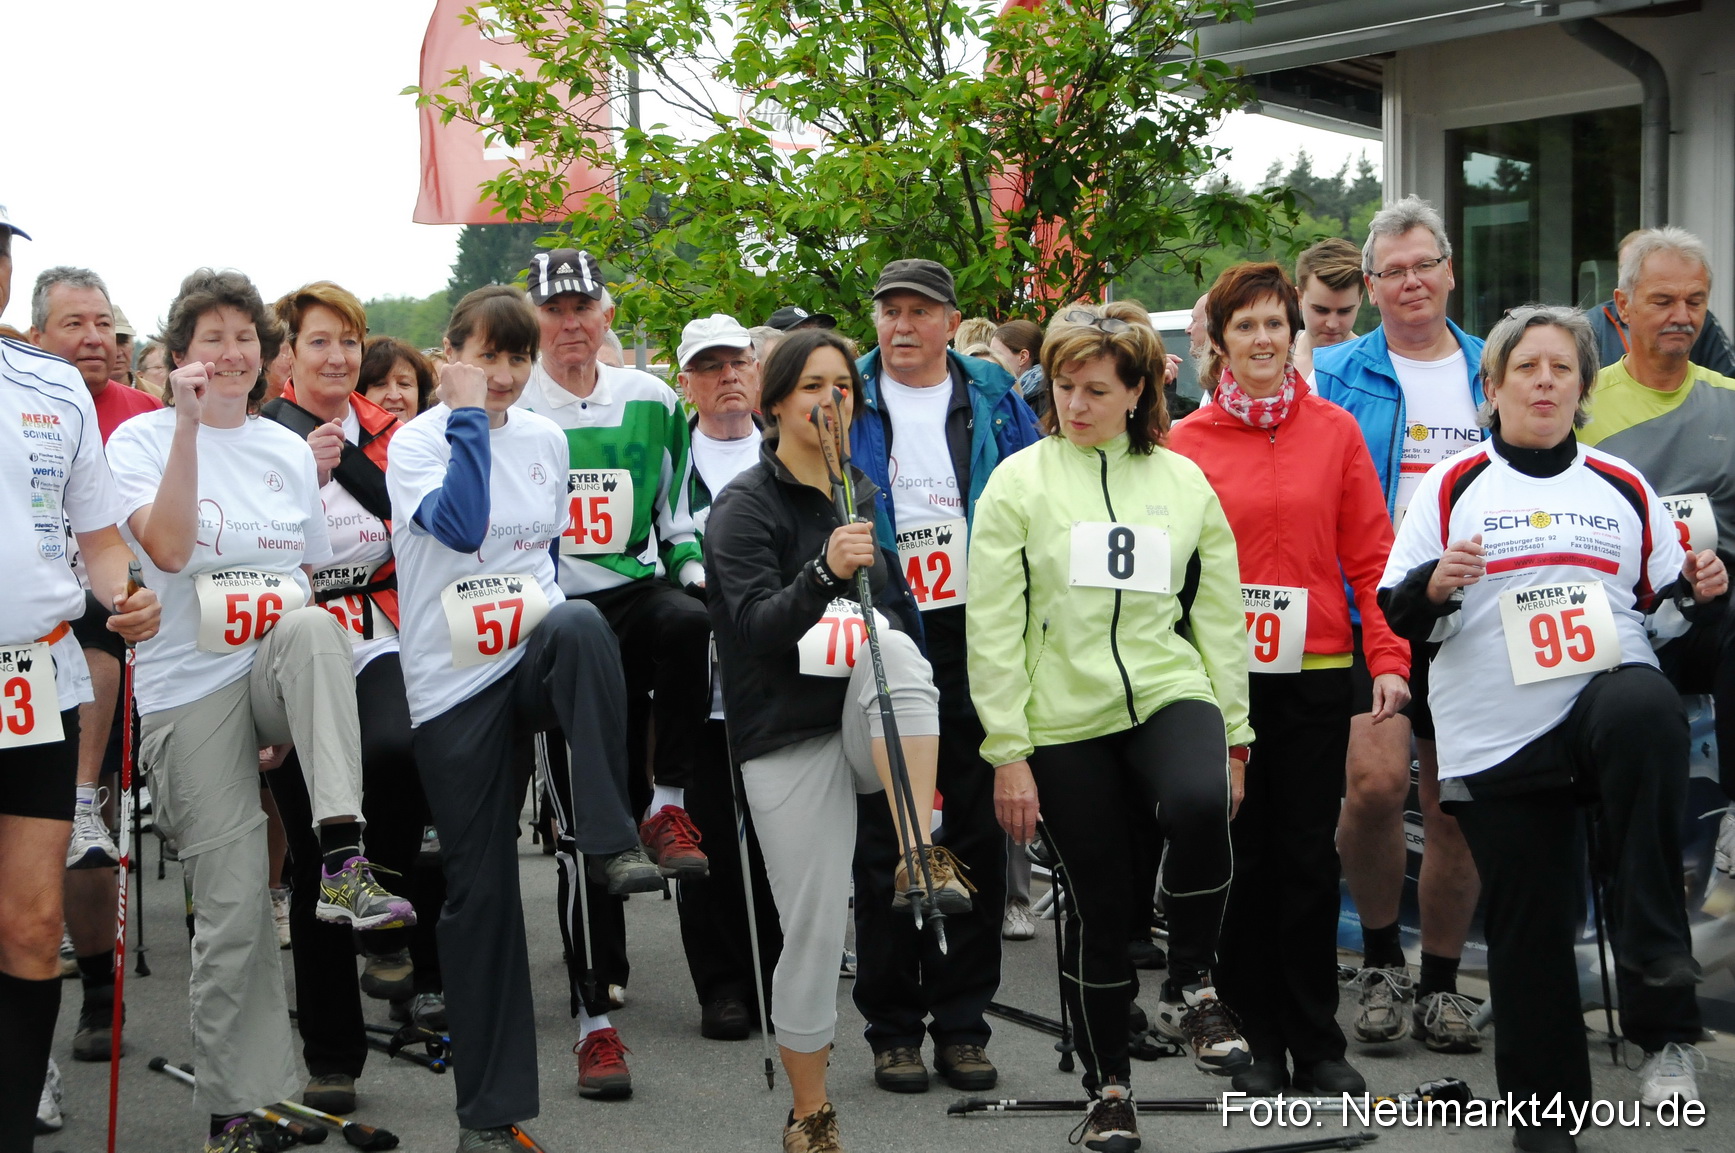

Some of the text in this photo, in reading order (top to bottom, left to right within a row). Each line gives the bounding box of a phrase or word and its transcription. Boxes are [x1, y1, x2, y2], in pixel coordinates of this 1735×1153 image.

[21, 412, 61, 425] MERZ
[897, 476, 933, 490] Sport
[225, 519, 261, 533] Sport
[327, 513, 363, 529] Sport
[562, 496, 613, 545] 45
[491, 523, 522, 539] Sport
[1484, 538, 1533, 549] Regensburger
[1594, 539, 1621, 550] Neumarkt
[1107, 526, 1135, 579] 8
[212, 571, 259, 581] MEYER
[813, 559, 834, 585] LEKI
[905, 551, 956, 604] 42
[213, 579, 262, 587] WERBUNG
[457, 577, 502, 594] MEYER
[458, 586, 506, 601] WERBUNG
[1516, 587, 1565, 605] MEYER
[1517, 596, 1567, 612] WERBUNG
[224, 592, 283, 646] 56
[472, 597, 524, 656] 57
[819, 617, 870, 668] 70
[1529, 607, 1596, 669] 95
